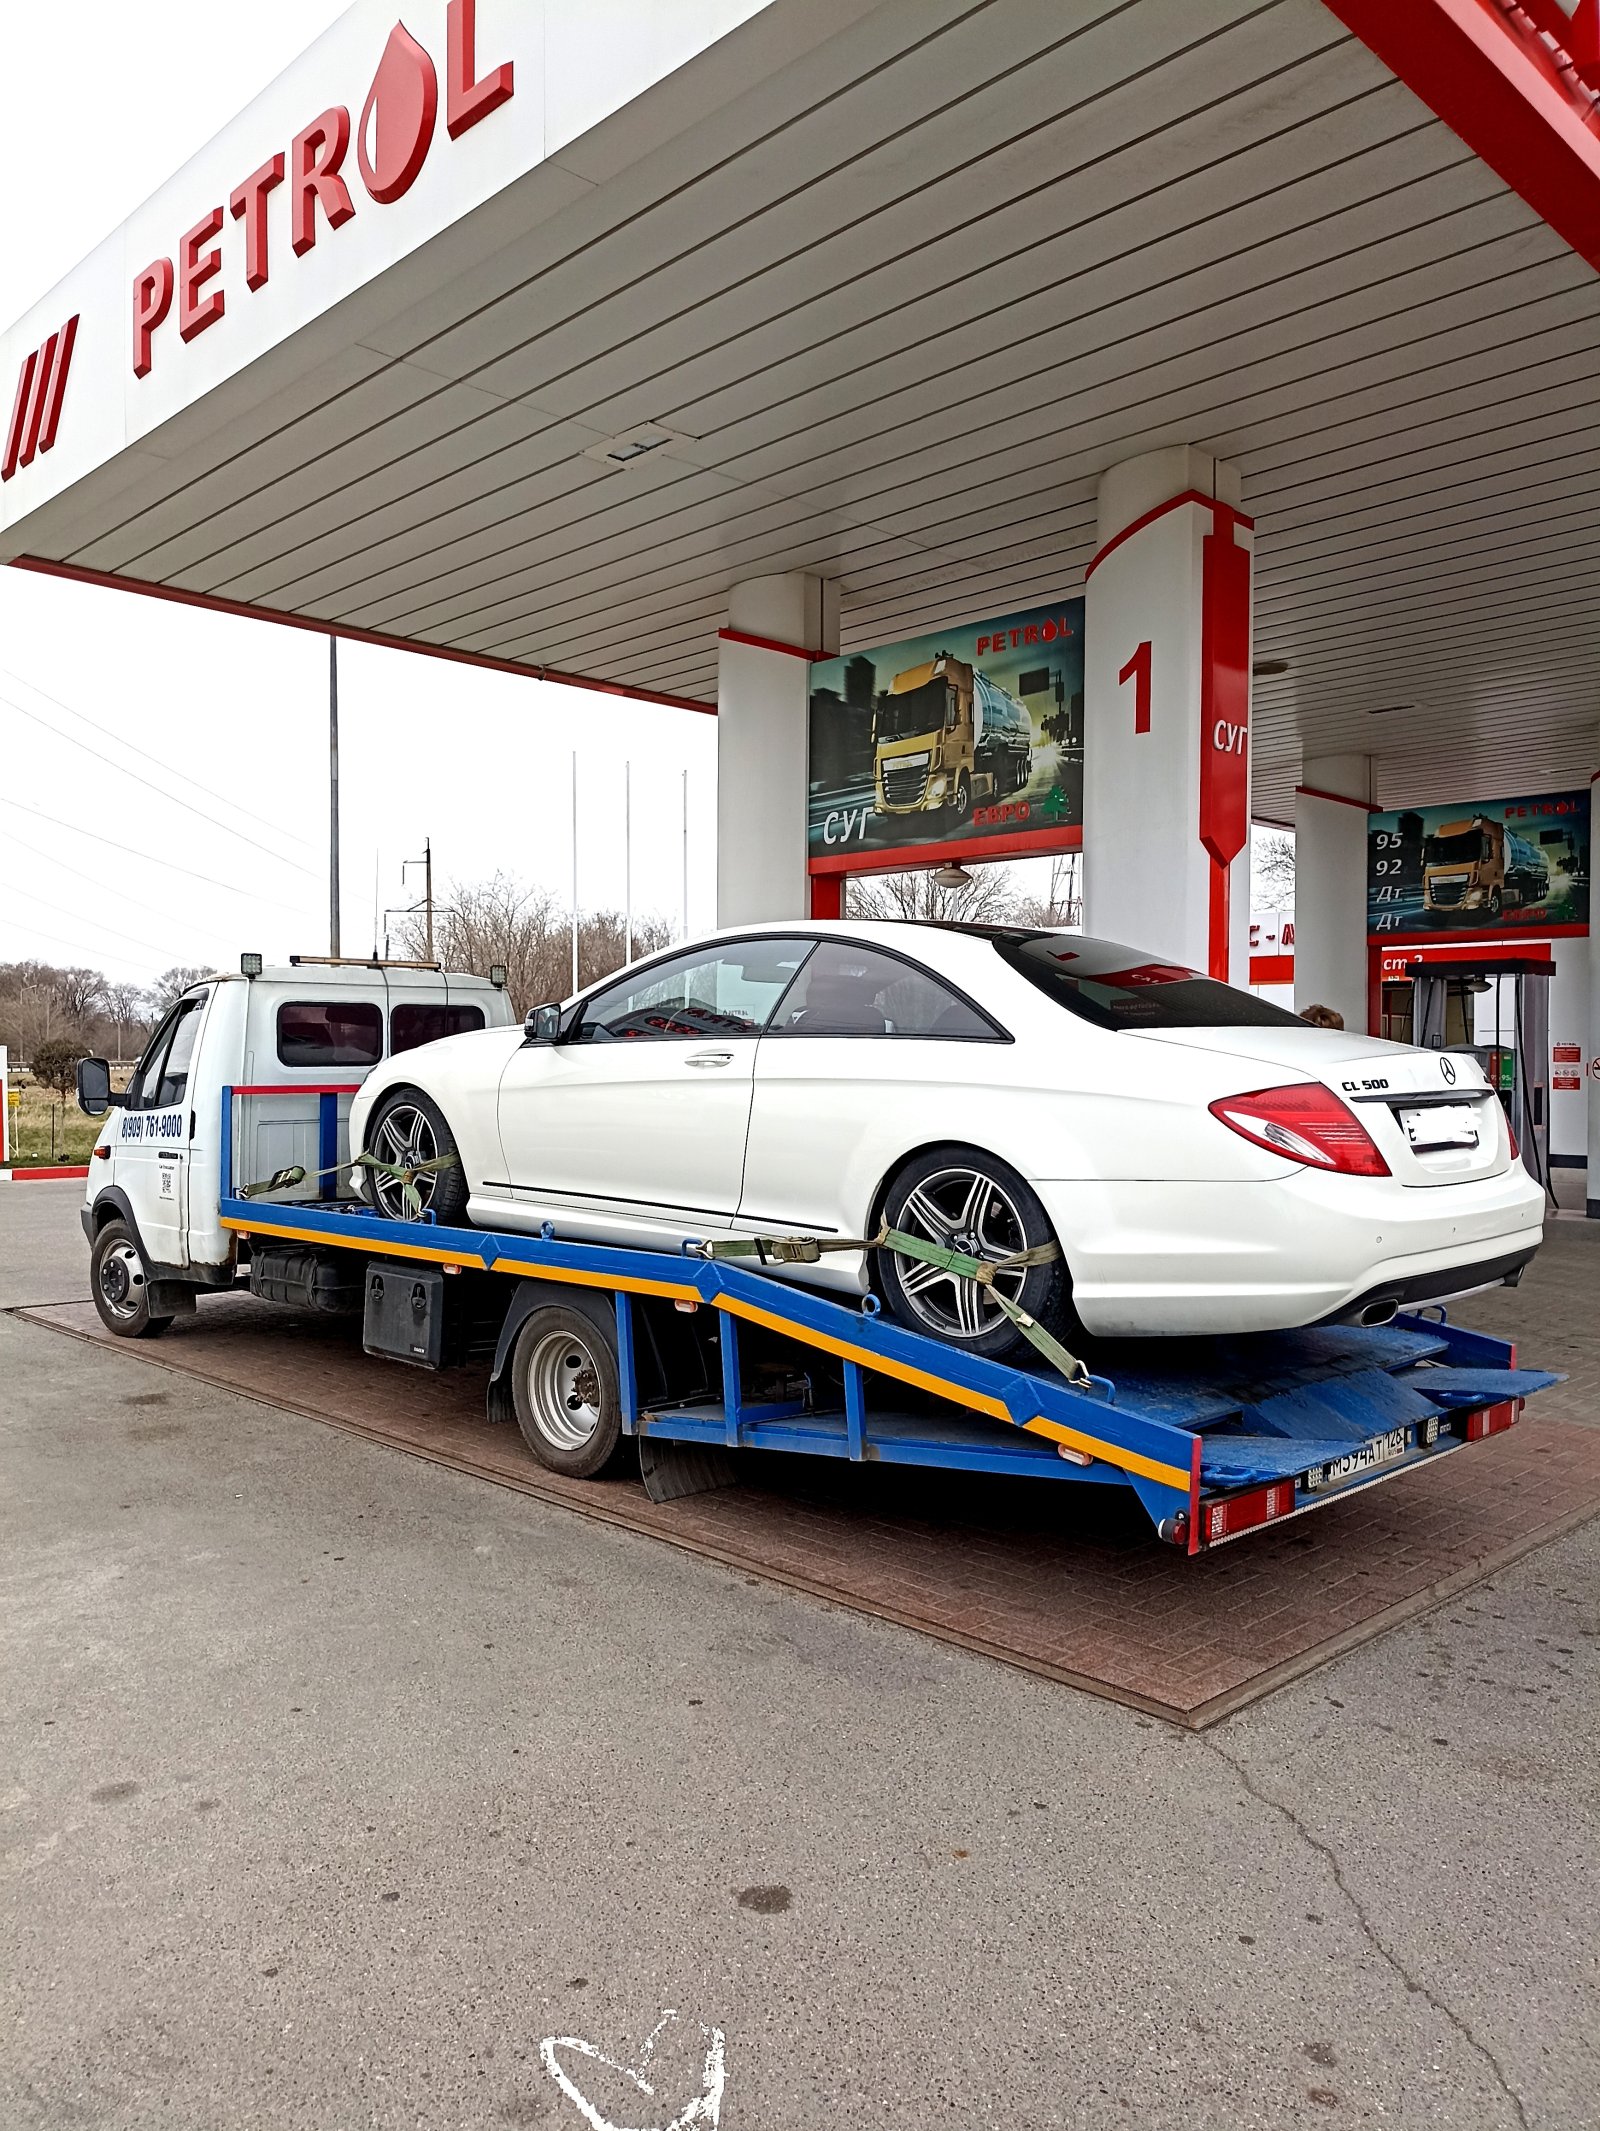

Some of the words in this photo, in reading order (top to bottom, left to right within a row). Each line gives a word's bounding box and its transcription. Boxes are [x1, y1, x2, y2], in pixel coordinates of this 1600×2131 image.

[133, 0, 514, 380] PETROL
[976, 616, 1074, 657] PETROL
[1118, 640, 1152, 735] 1
[1504, 801, 1580, 819] PETROL
[1376, 832, 1403, 850] 95
[1376, 859, 1402, 876] 92
[1341, 1081, 1360, 1091] CL
[1361, 1079, 1389, 1090] 500
[122, 1115, 143, 1143] 8(909)
[145, 1114, 182, 1138] 761-9000
